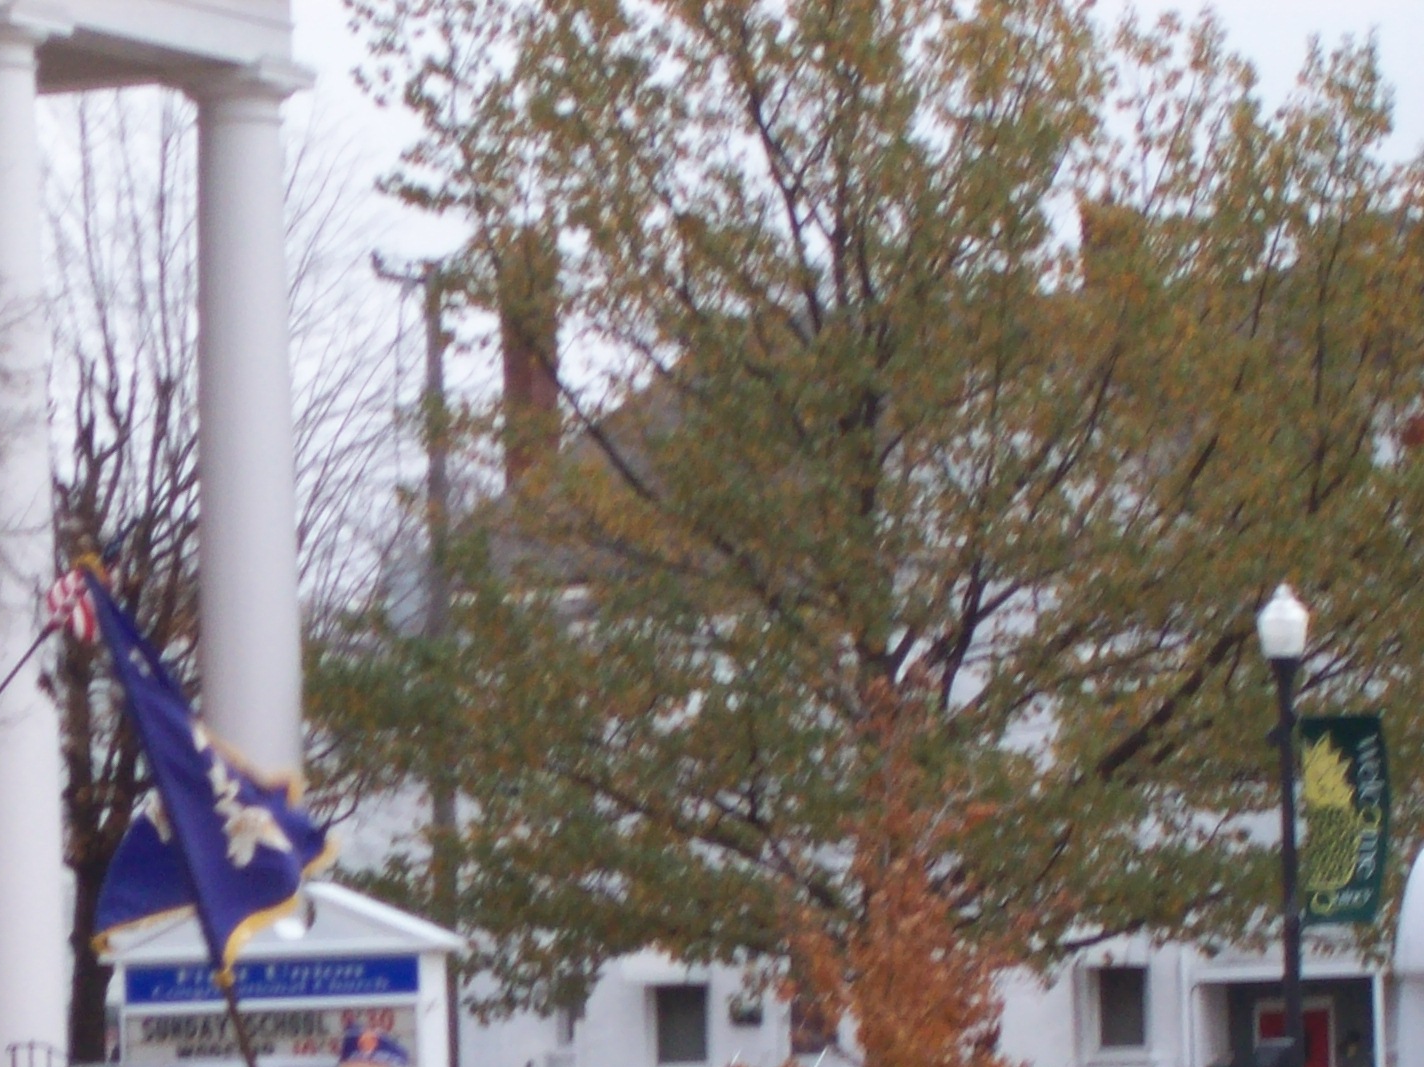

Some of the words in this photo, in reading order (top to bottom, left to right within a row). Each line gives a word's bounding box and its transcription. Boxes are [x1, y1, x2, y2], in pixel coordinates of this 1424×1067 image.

[176, 964, 249, 986] Firt
[141, 1014, 231, 1043] SUNDAY
[238, 1008, 330, 1039] SCHOOL
